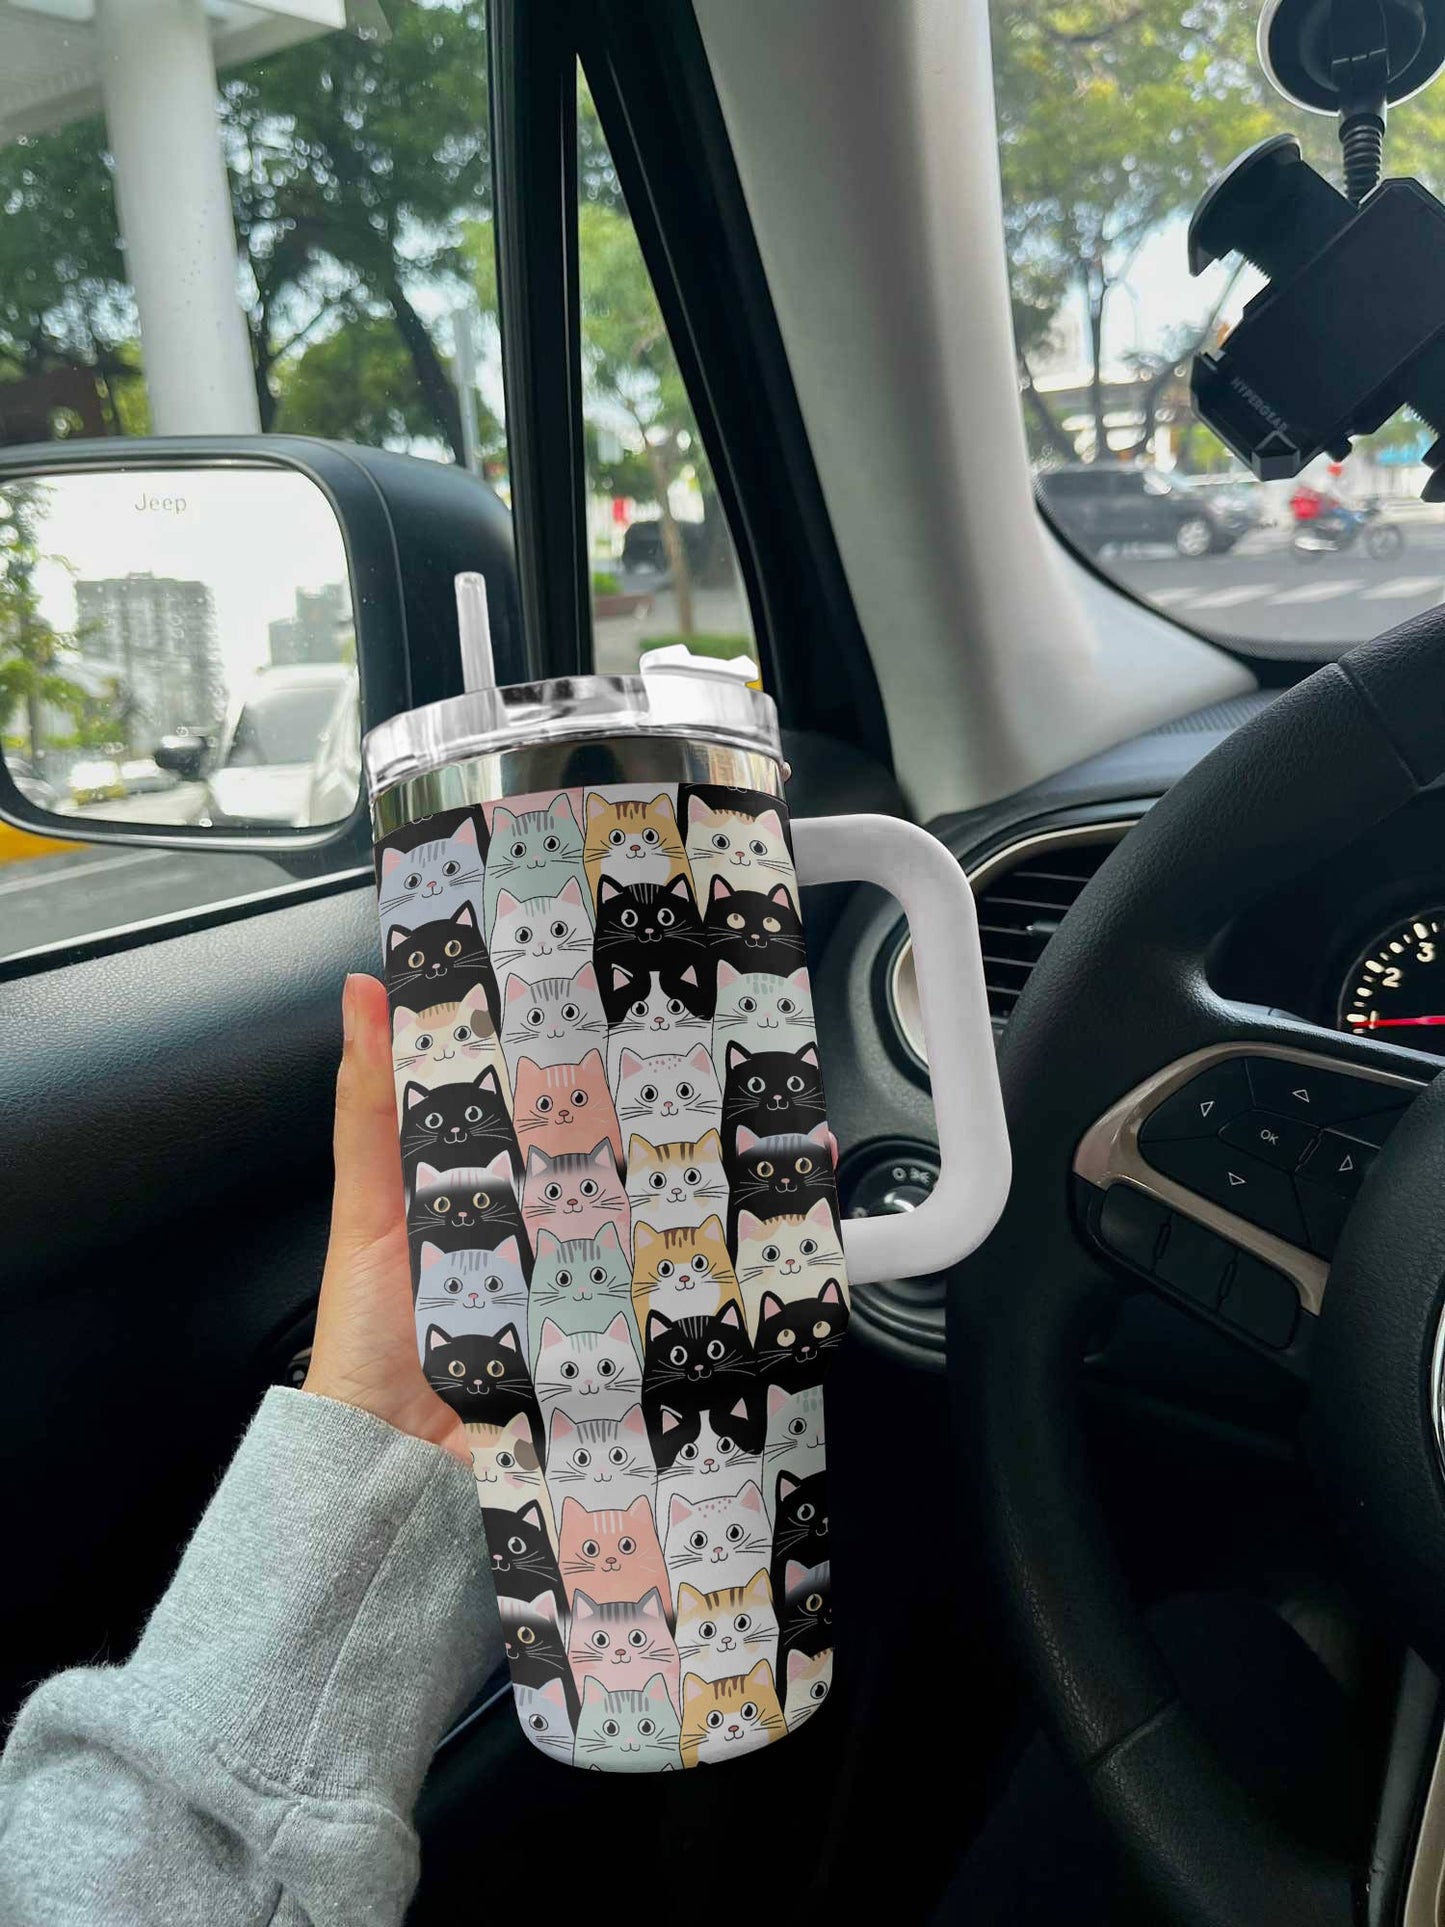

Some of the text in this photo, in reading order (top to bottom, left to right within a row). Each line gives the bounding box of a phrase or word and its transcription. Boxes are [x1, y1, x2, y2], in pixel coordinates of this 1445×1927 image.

[1230, 376, 1288, 432] HYPERGEAR
[134, 492, 187, 515] Jeep
[1416, 941, 1435, 963] 3
[1382, 966, 1403, 988] 2
[1260, 1129, 1279, 1146] OK
